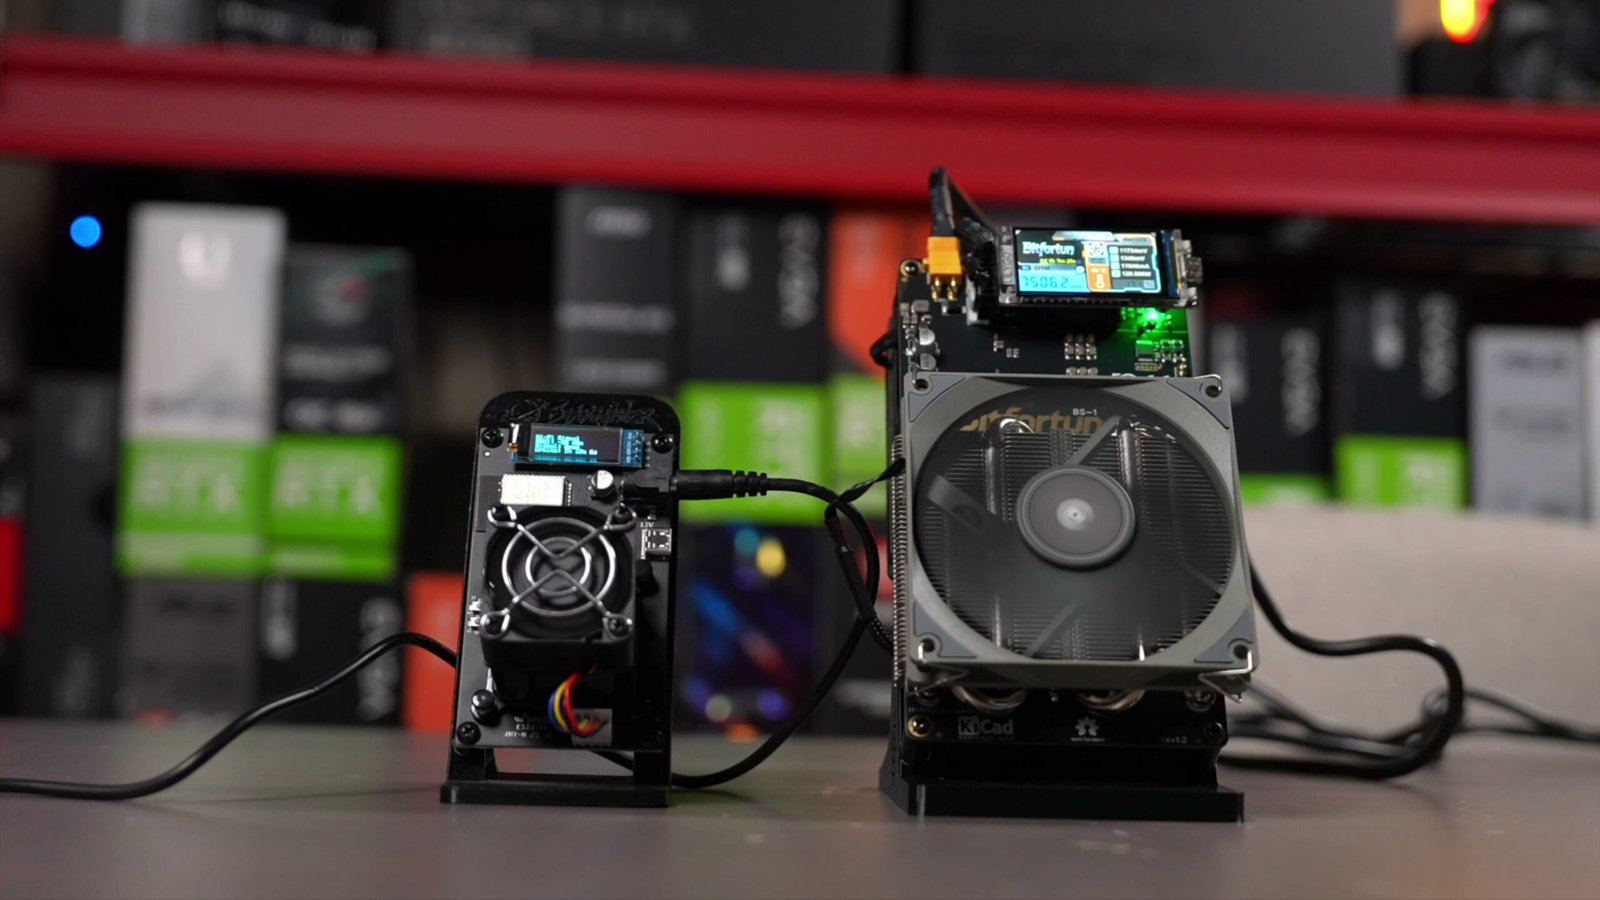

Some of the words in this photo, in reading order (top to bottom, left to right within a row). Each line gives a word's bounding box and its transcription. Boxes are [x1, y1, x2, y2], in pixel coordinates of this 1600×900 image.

[1022, 241, 1075, 256] Bitfortun
[1072, 407, 1098, 416] BS-1
[957, 715, 1014, 736] KiCad
